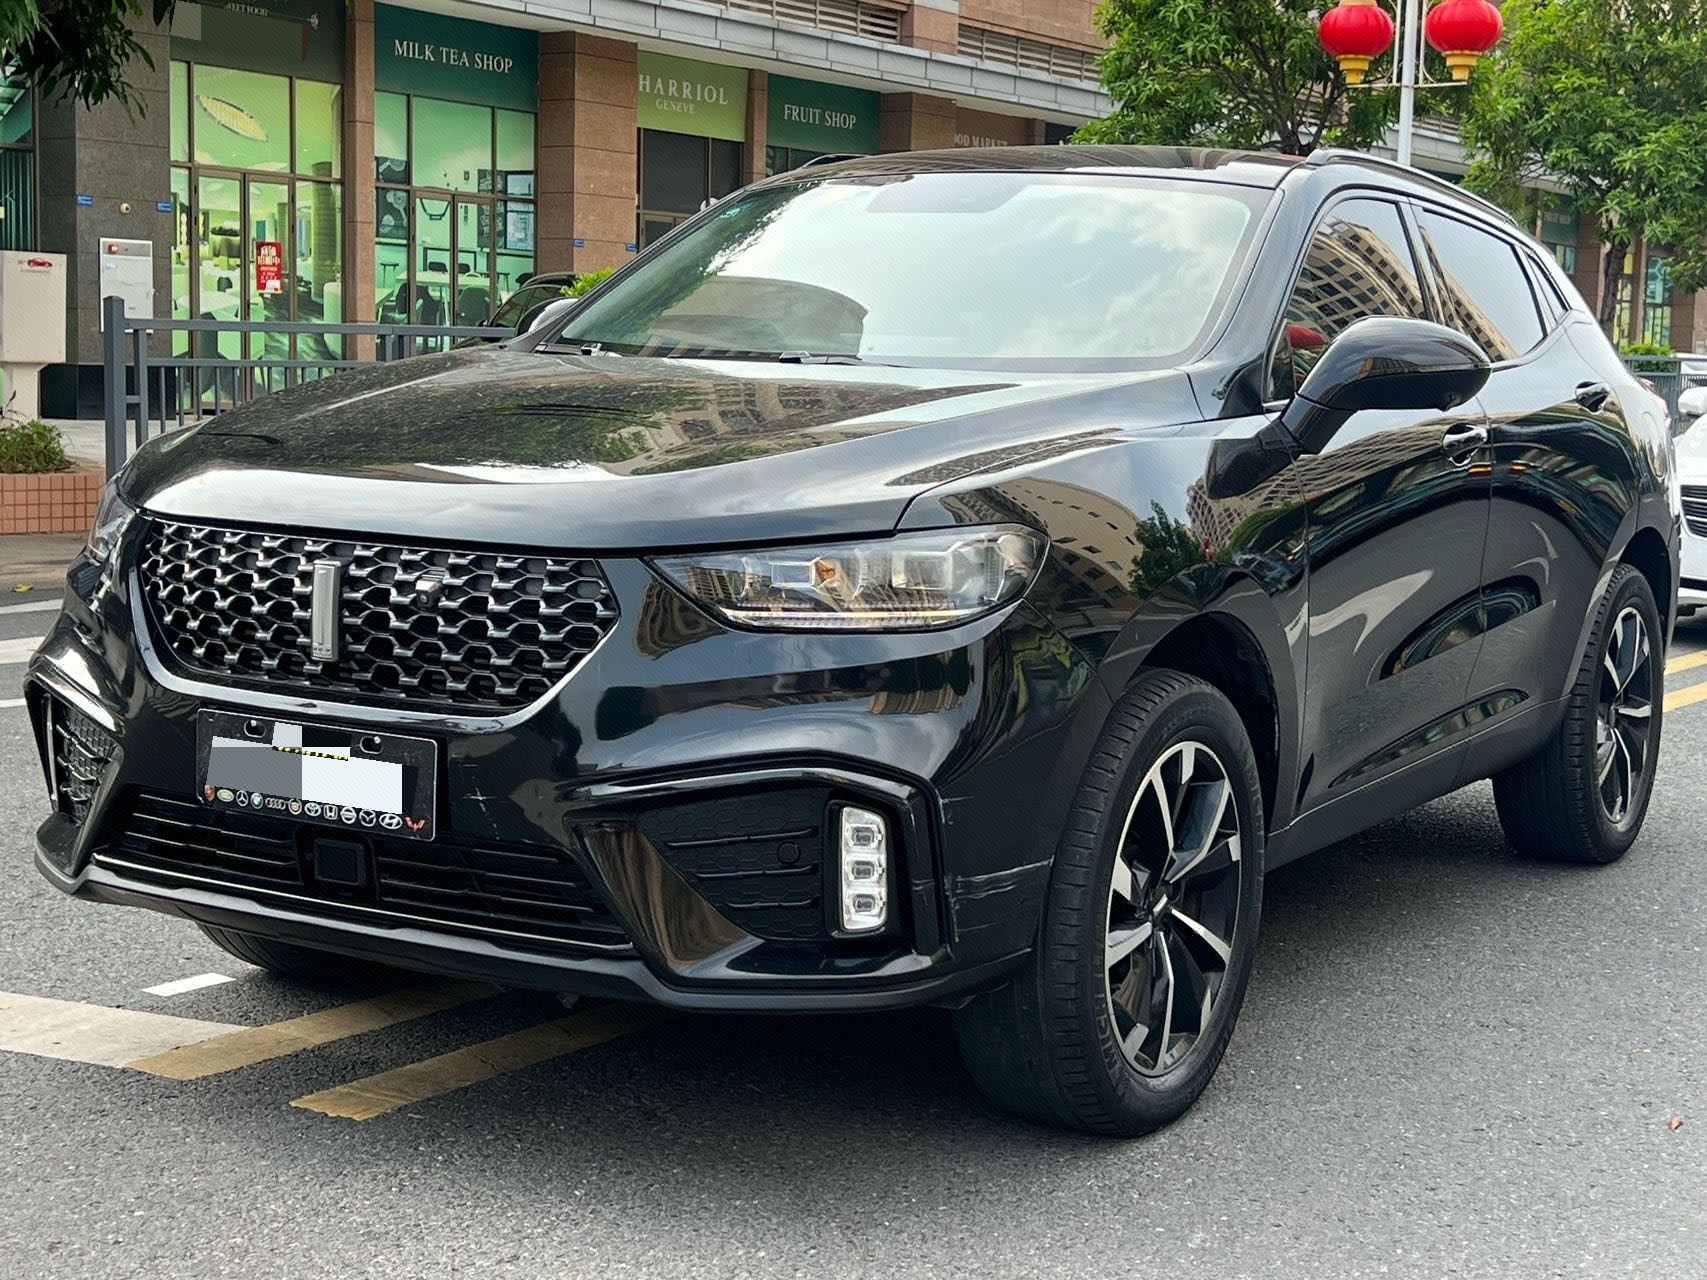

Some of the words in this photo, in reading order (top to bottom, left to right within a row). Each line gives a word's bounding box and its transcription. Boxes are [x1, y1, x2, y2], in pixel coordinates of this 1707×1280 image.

[394, 38, 435, 61] MILK
[440, 46, 470, 67] TEA
[474, 52, 513, 73] SHOP
[639, 74, 729, 105] HARRIOL
[784, 103, 822, 124] FRUIT
[825, 110, 857, 129] SHOP
